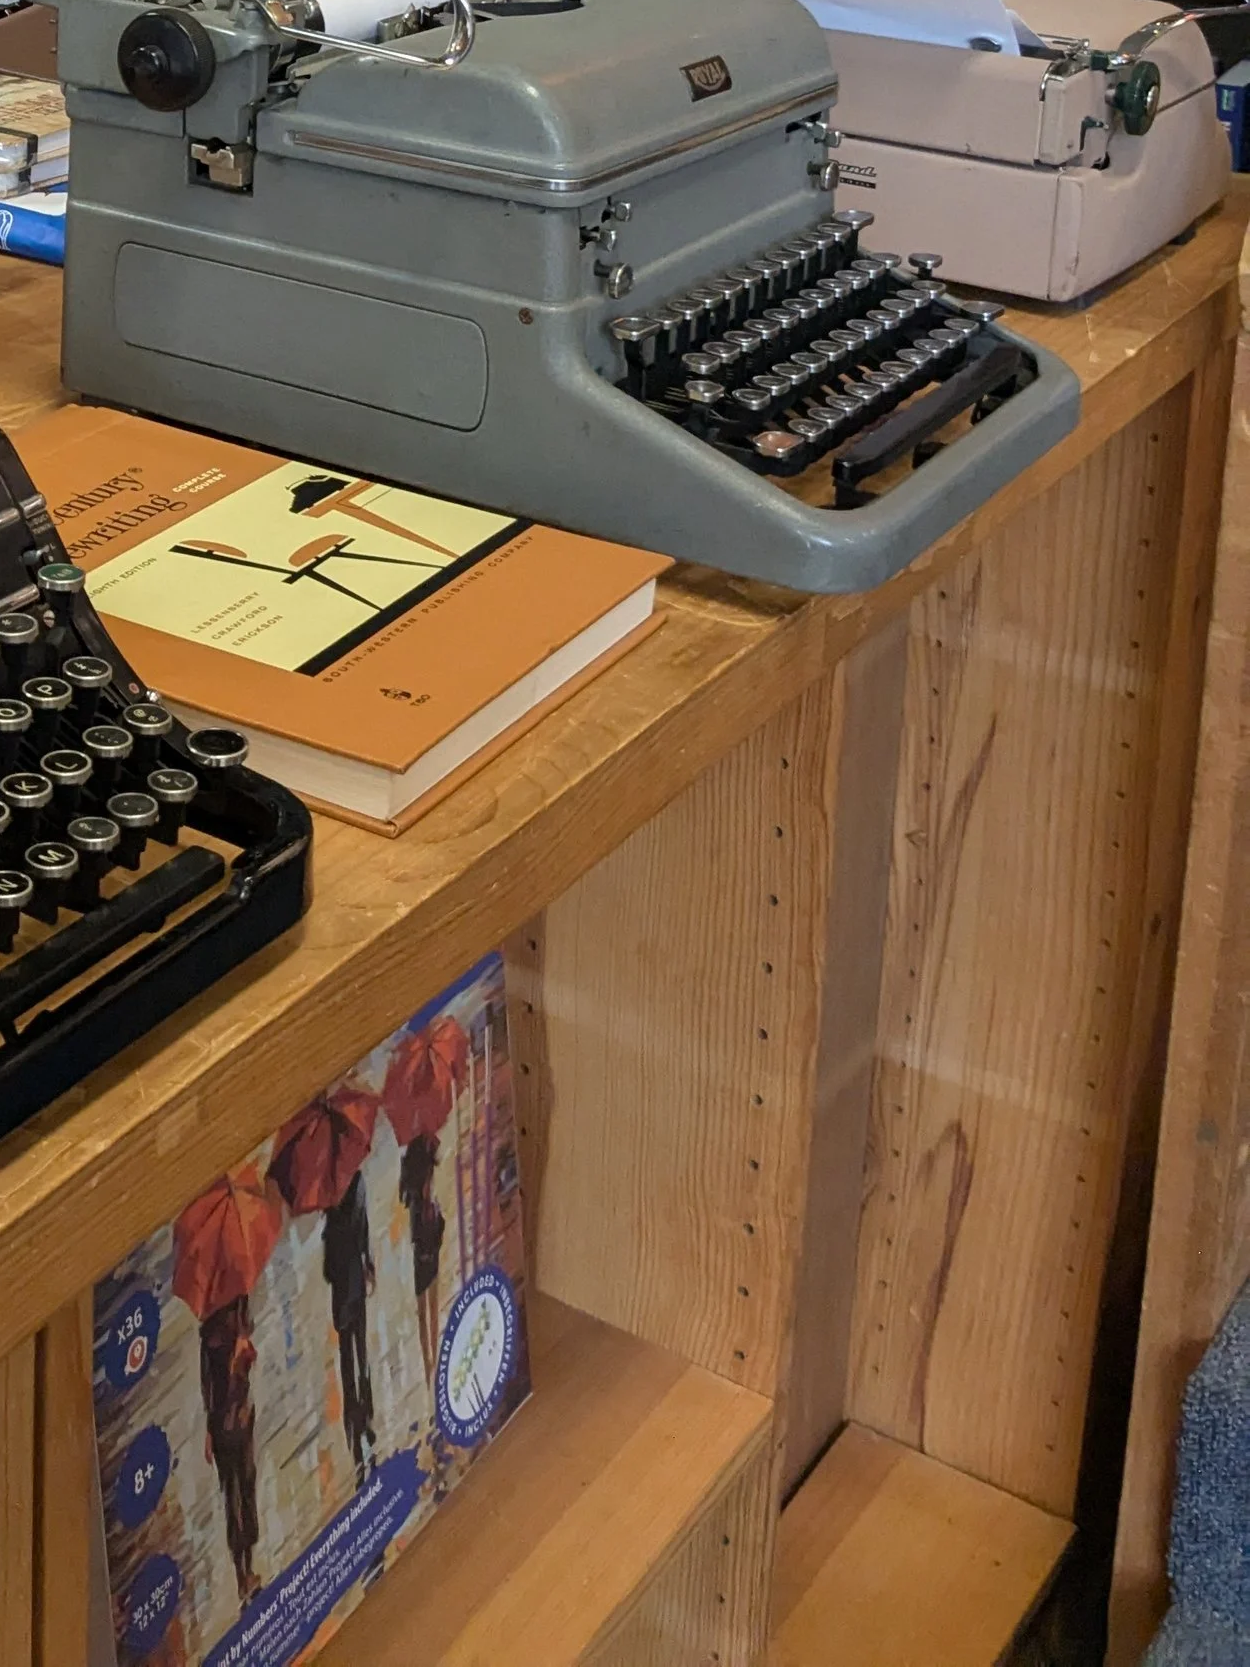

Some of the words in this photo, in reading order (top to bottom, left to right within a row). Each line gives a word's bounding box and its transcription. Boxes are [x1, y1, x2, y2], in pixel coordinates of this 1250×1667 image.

[687, 62, 728, 90] ROYAL
[172, 467, 221, 493] COMPLETE
[189, 474, 227, 493] COURSE
[120, 557, 157, 580] EDITION
[191, 591, 260, 634] LESSENBERRY
[212, 605, 268, 640] CRAWFORD
[322, 617, 418, 683] SOUTH-WESTERN
[421, 570, 485, 614] PUBLISHING
[488, 536, 534, 568] COMPANY
[231, 614, 284, 647] ERICKSON
[454, 1274, 495, 1319] INCLUDED
[117, 1307, 144, 1345] x36
[134, 1461, 155, 1494] 8+
[241, 1594, 280, 1644] Numbers'
[279, 1565, 310, 1604] Project!
[309, 1517, 350, 1569] Everything
[349, 1477, 383, 1522] included.
